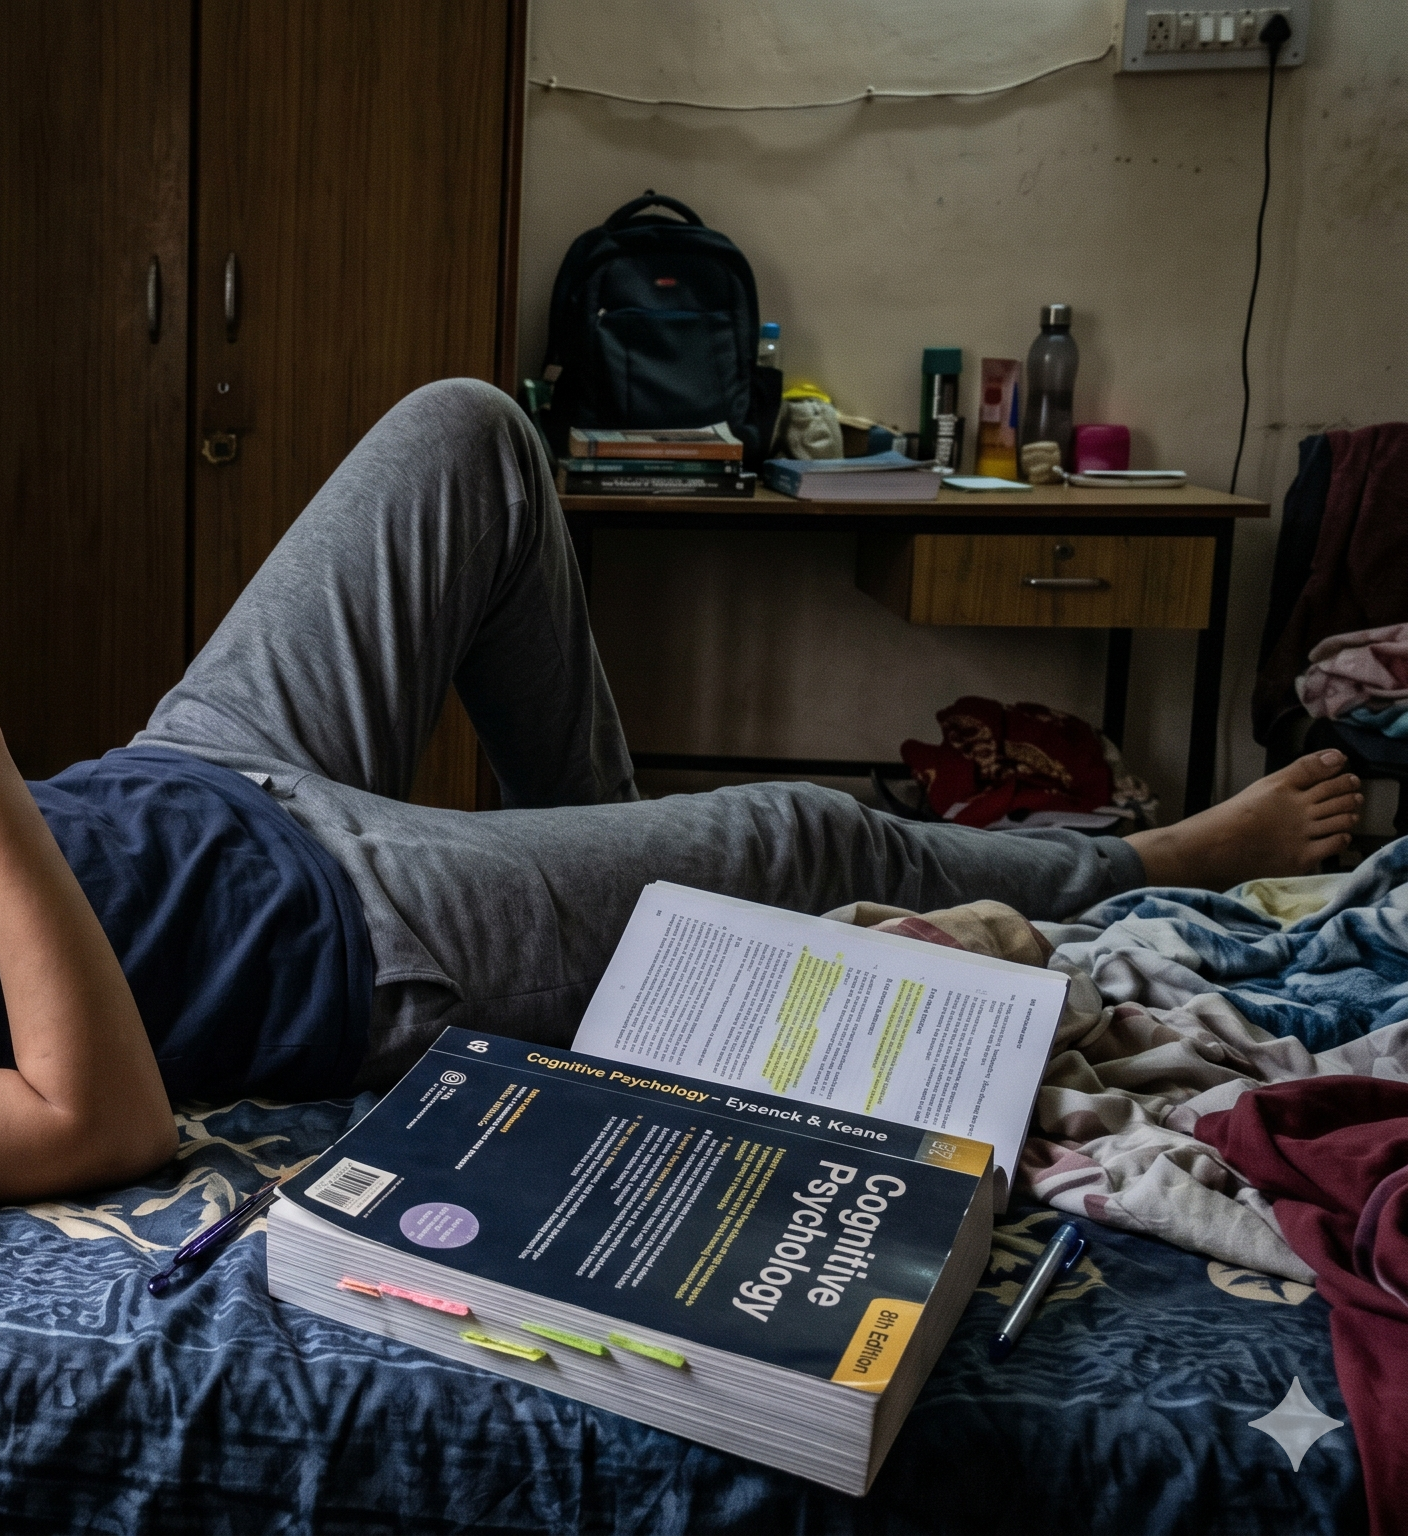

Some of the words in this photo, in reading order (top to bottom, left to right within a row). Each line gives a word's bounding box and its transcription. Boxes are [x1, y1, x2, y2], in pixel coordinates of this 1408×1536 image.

[526, 1052, 606, 1078] Cognitive
[725, 1096, 804, 1123] Eysenck
[806, 1115, 823, 1127] &
[827, 1119, 888, 1142] Keane
[732, 1159, 859, 1323] Psychology
[807, 1173, 908, 1307] Cognitive
[873, 1309, 900, 1330] 8th
